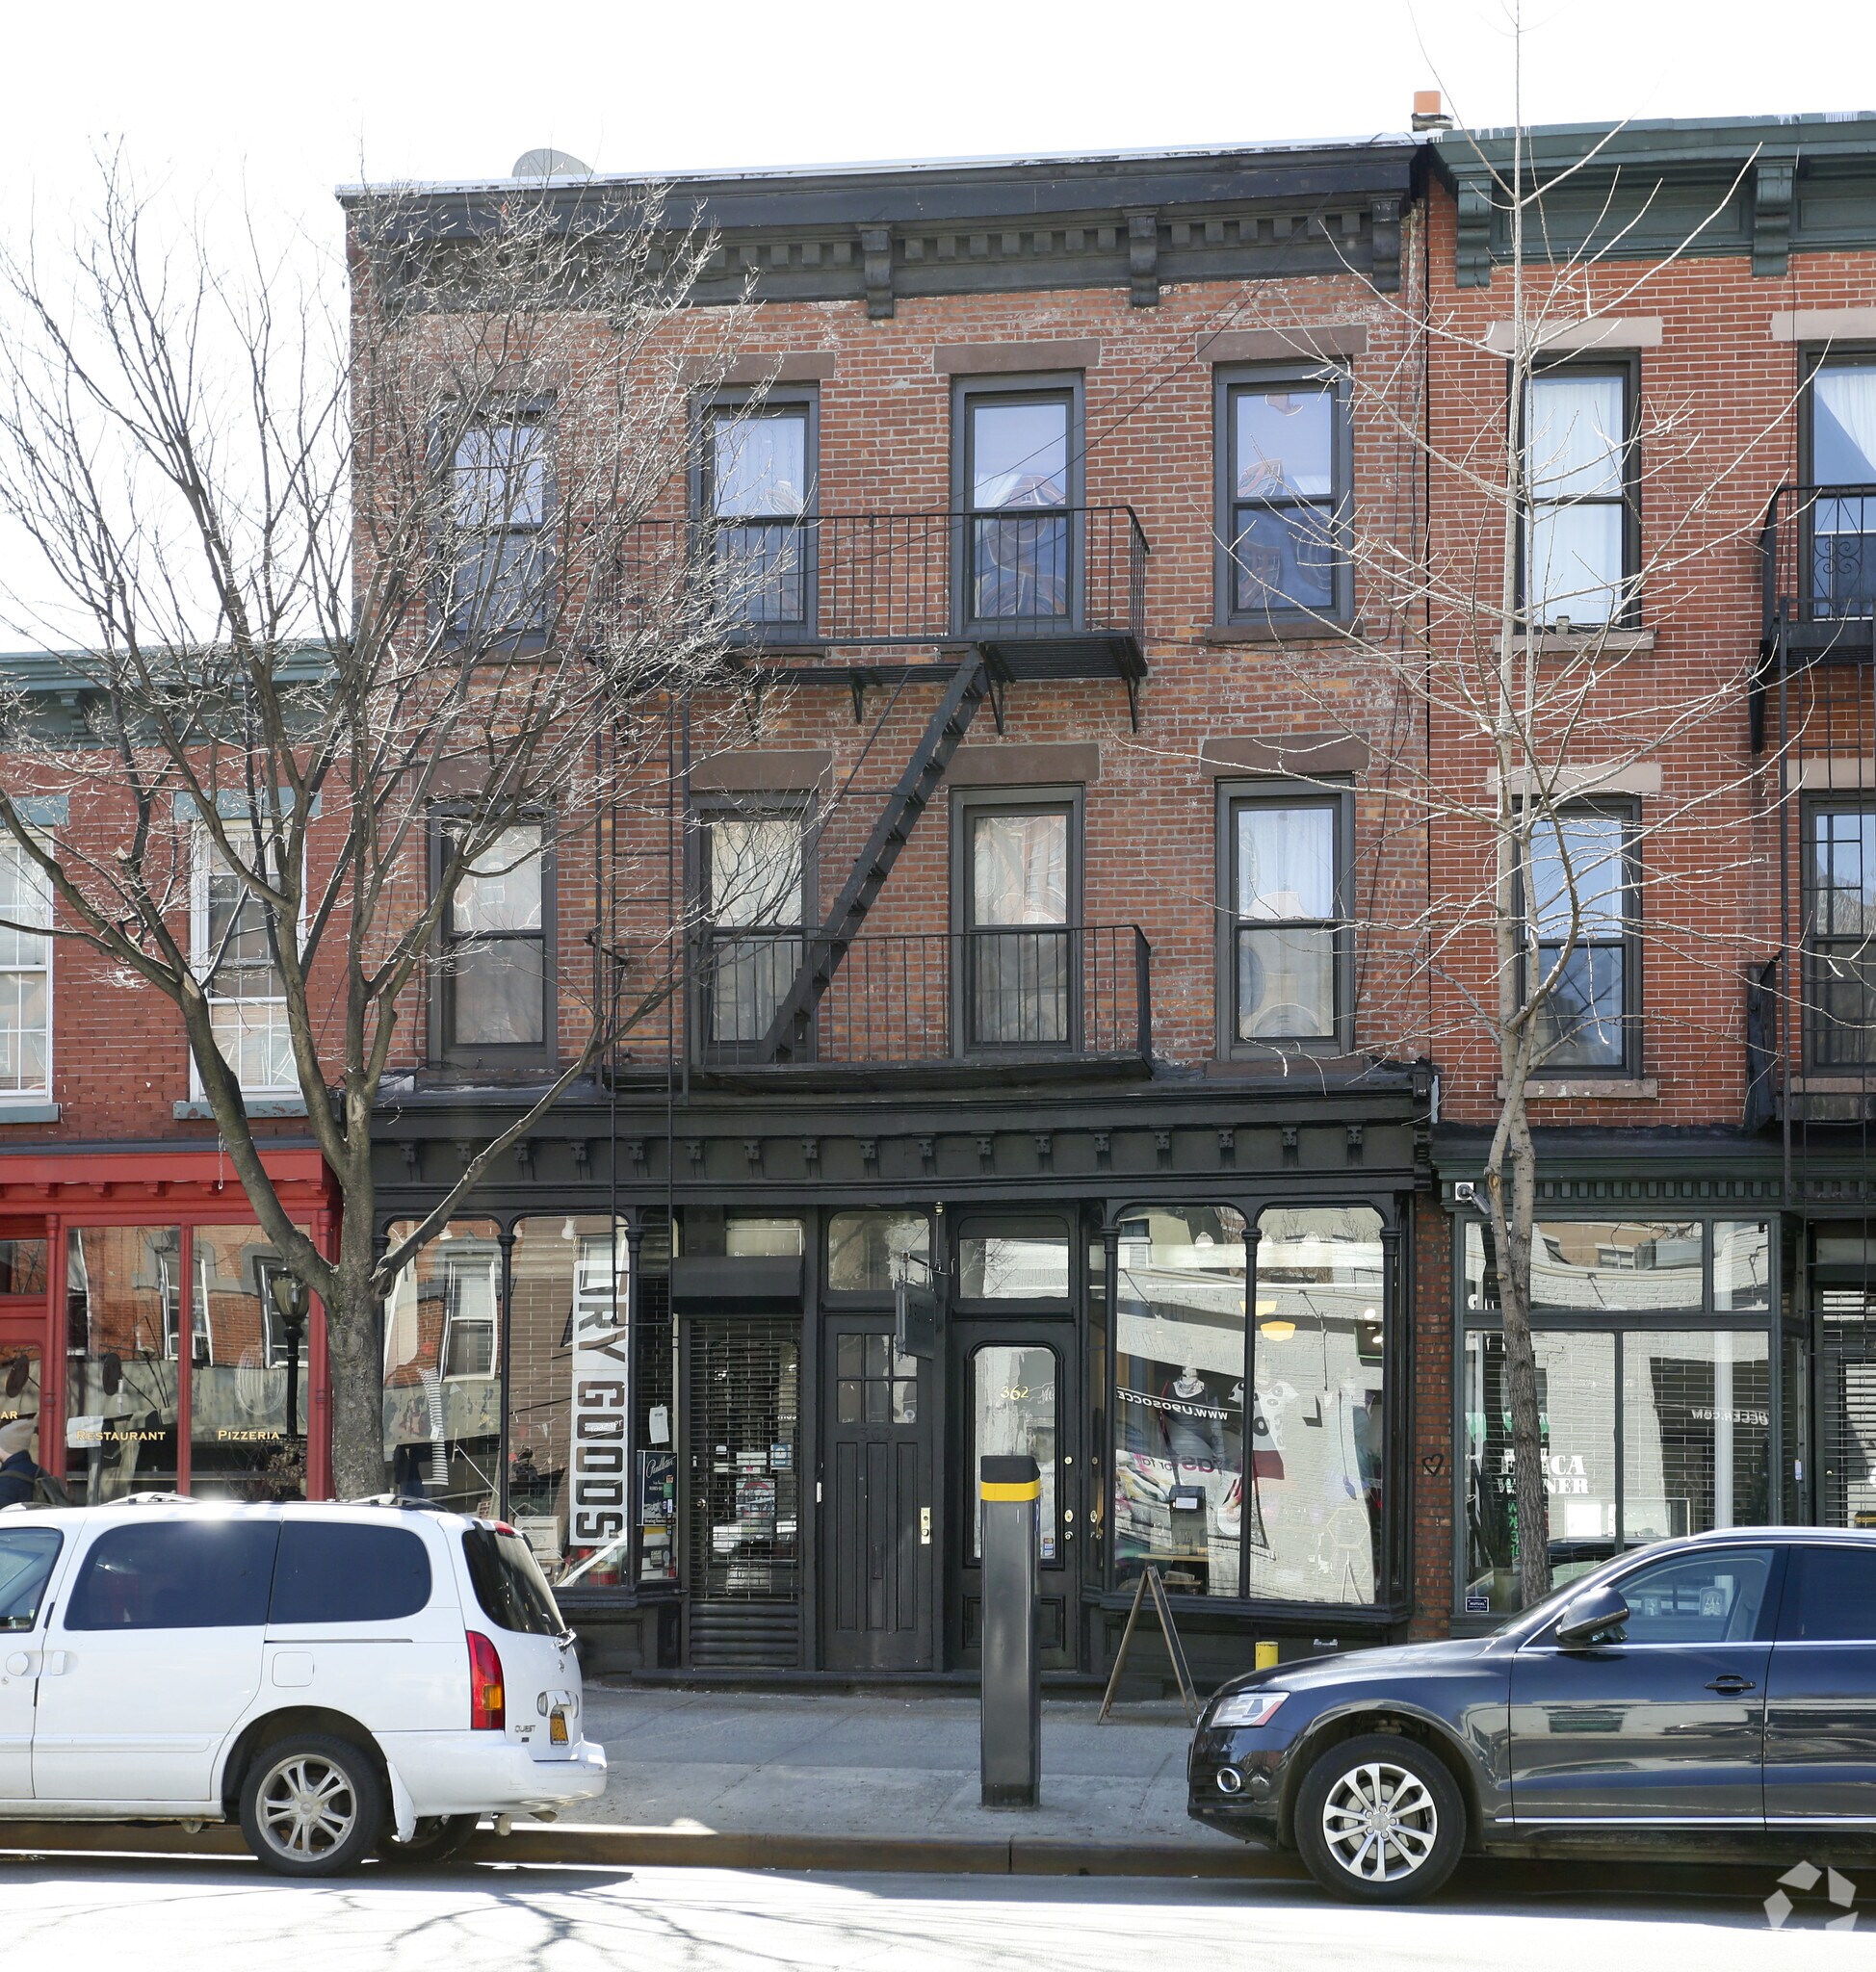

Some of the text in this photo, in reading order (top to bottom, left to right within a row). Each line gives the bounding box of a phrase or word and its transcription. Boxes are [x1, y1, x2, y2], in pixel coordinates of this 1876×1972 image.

[1000, 1384, 1029, 1401] 362
[76, 1430, 166, 1440] RESTAURANT
[218, 1430, 280, 1440] PIZZERIA
[576, 1381, 625, 1540] GOODS
[1500, 1455, 1588, 1475] EICA
[1496, 1478, 1590, 1493] WNER
[514, 1725, 536, 1733] QUEST
